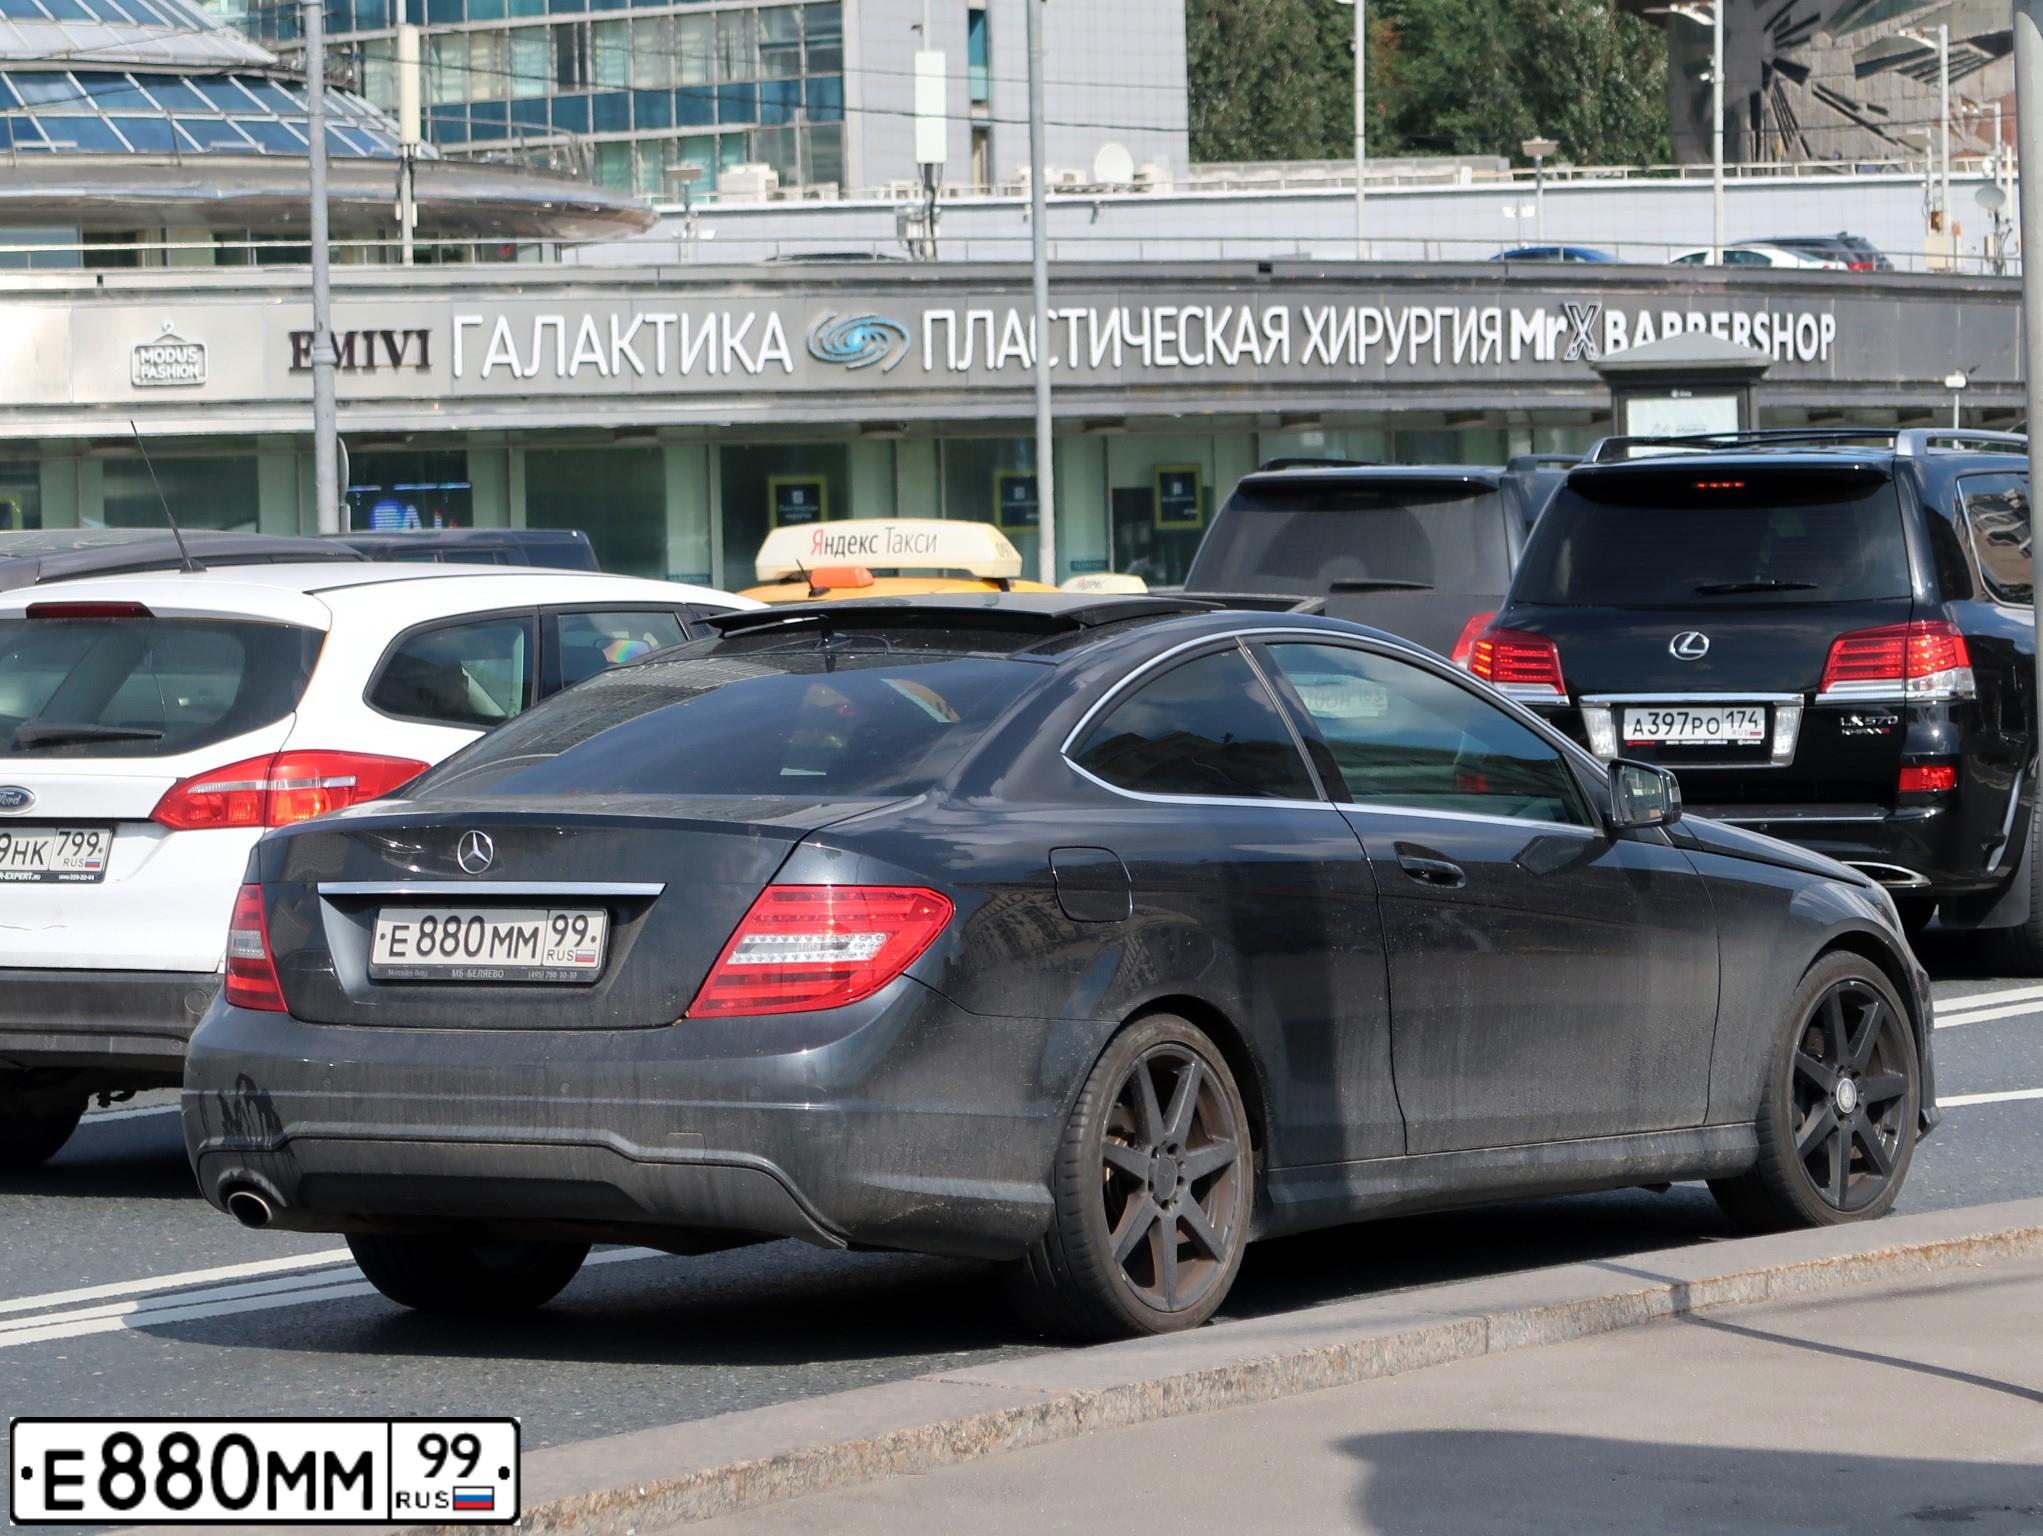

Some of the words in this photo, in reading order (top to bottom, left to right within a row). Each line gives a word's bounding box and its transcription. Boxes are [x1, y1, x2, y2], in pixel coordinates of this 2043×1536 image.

[452, 310, 795, 379] ГАЛАКТИКА
[921, 306, 1290, 372] ПЛАСТИЧЕСКАЯ
[1301, 304, 1502, 366] ХИРУРГИЯ
[141, 346, 199, 364] MODUS
[289, 329, 432, 374] EMIVI
[141, 364, 199, 379] FASHION
[811, 528, 880, 559] Яндекс
[884, 526, 938, 555] Такси
[1725, 710, 1759, 729] 174
[57, 831, 101, 857] 799
[63, 858, 85, 868] RUS
[551, 914, 590, 948] 99
[545, 950, 575, 963] RUS
